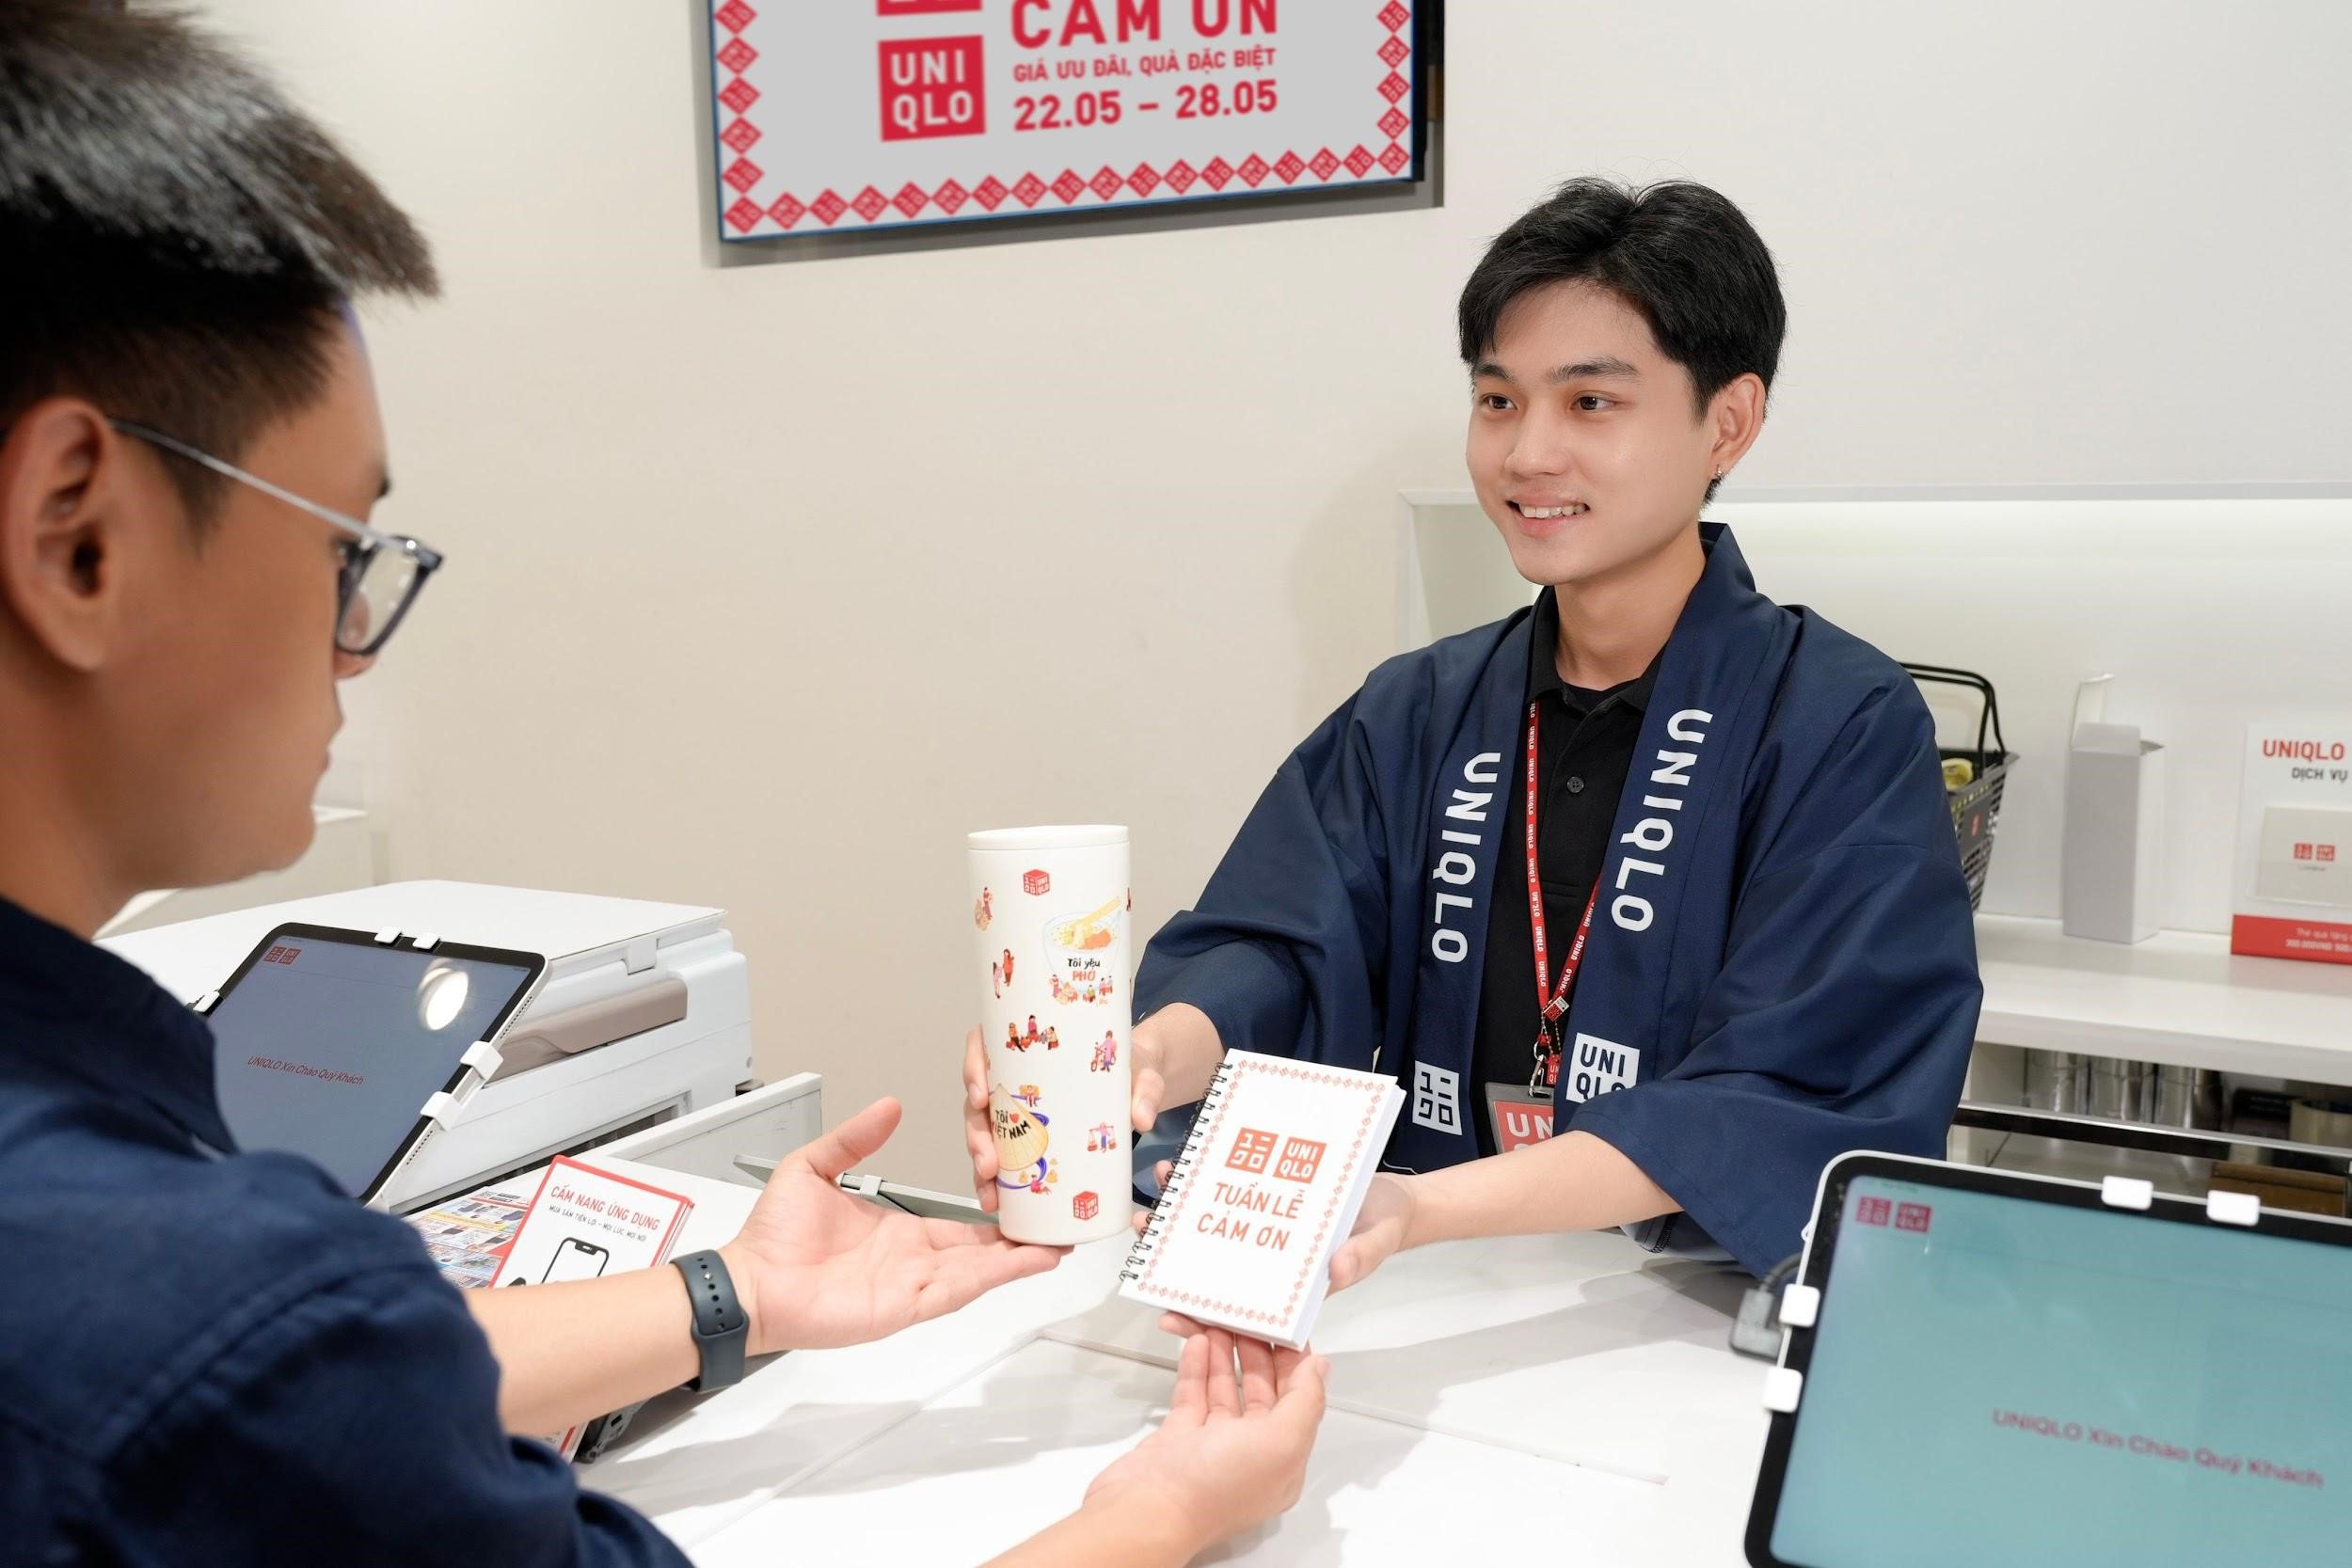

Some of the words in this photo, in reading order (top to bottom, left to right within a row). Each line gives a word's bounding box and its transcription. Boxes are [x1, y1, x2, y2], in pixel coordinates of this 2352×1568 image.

[890, 49, 966, 87] UNI
[1013, 57, 1048, 83] GIÁ
[1139, 49, 1181, 76] QUÀ
[1187, 48, 1227, 75] ĐẶC
[1233, 45, 1278, 71] BIỆT
[892, 89, 975, 134] QLO
[1013, 89, 1123, 132] 22.05
[1174, 78, 1279, 119] 28.05
[2262, 737, 2347, 763] UNIQLO
[1611, 708, 1713, 932] UNIQLO
[1431, 752, 1502, 963] UNIQLO
[1534, 926, 1545, 953] UNIQLO
[1067, 958, 1082, 967] Tôi
[1084, 958, 1101, 970] yêu
[247, 1055, 281, 1069] UNIQLO
[1581, 1043, 1626, 1077] UNI
[1009, 1120, 1031, 1140] NAM
[1506, 1112, 1553, 1140] UN
[1279, 1158, 1314, 1179] QLO
[1286, 1141, 1319, 1163] UNI
[575, 1193, 606, 1213] NANG
[630, 1212, 661, 1231] DỤNG
[1992, 1407, 2085, 1442] UNIQLO
